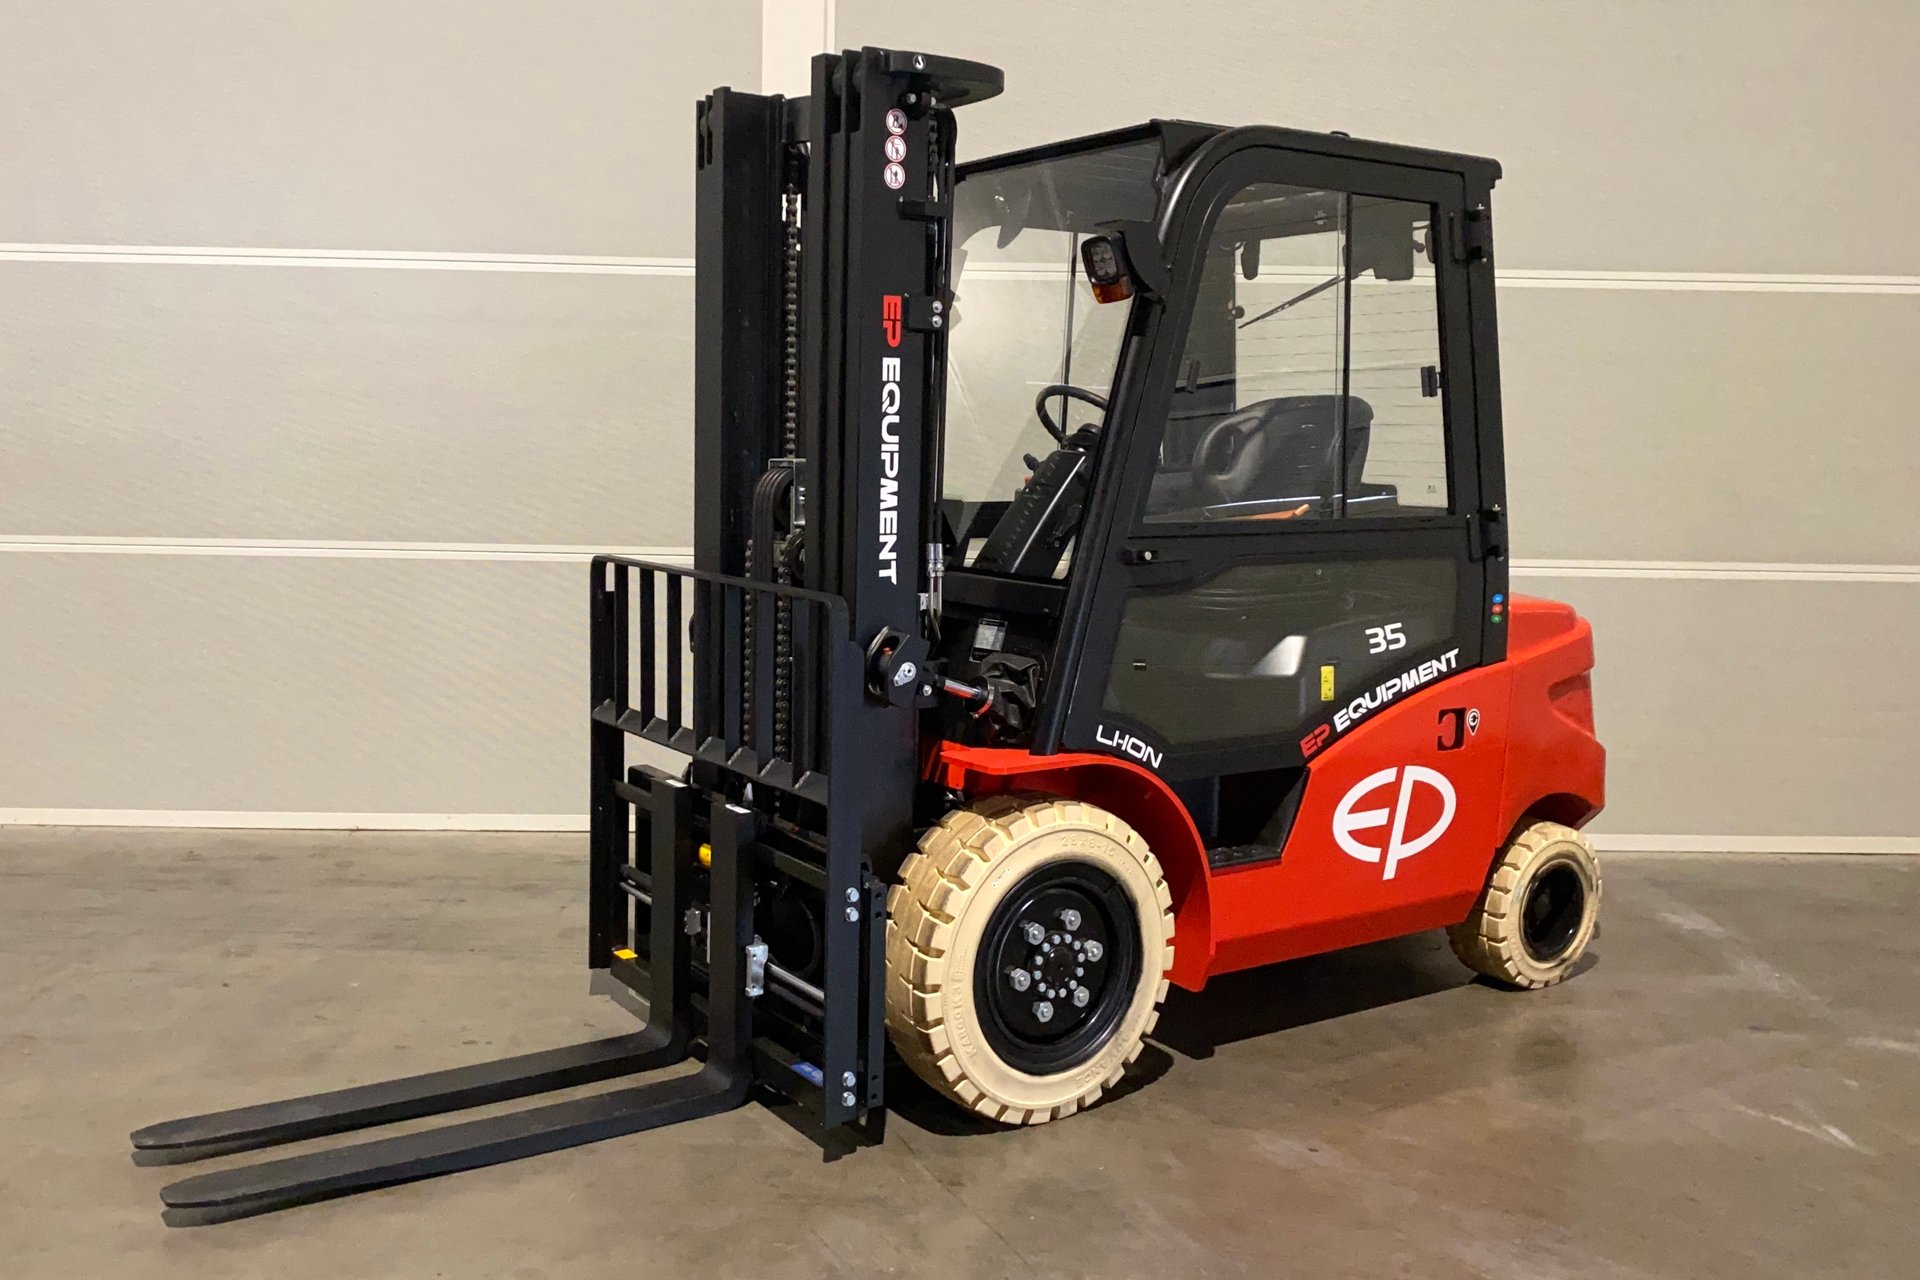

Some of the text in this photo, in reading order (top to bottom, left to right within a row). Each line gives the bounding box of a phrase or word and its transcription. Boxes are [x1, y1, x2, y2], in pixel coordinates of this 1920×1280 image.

[878, 295, 902, 585] EP EQUIPMENT
[1365, 622, 1407, 655] 35
[1096, 724, 1164, 769] LI-ION
[1300, 723, 1331, 759] EP
[1333, 648, 1460, 733] EQUIPMENT
[1332, 765, 1457, 881] EP
